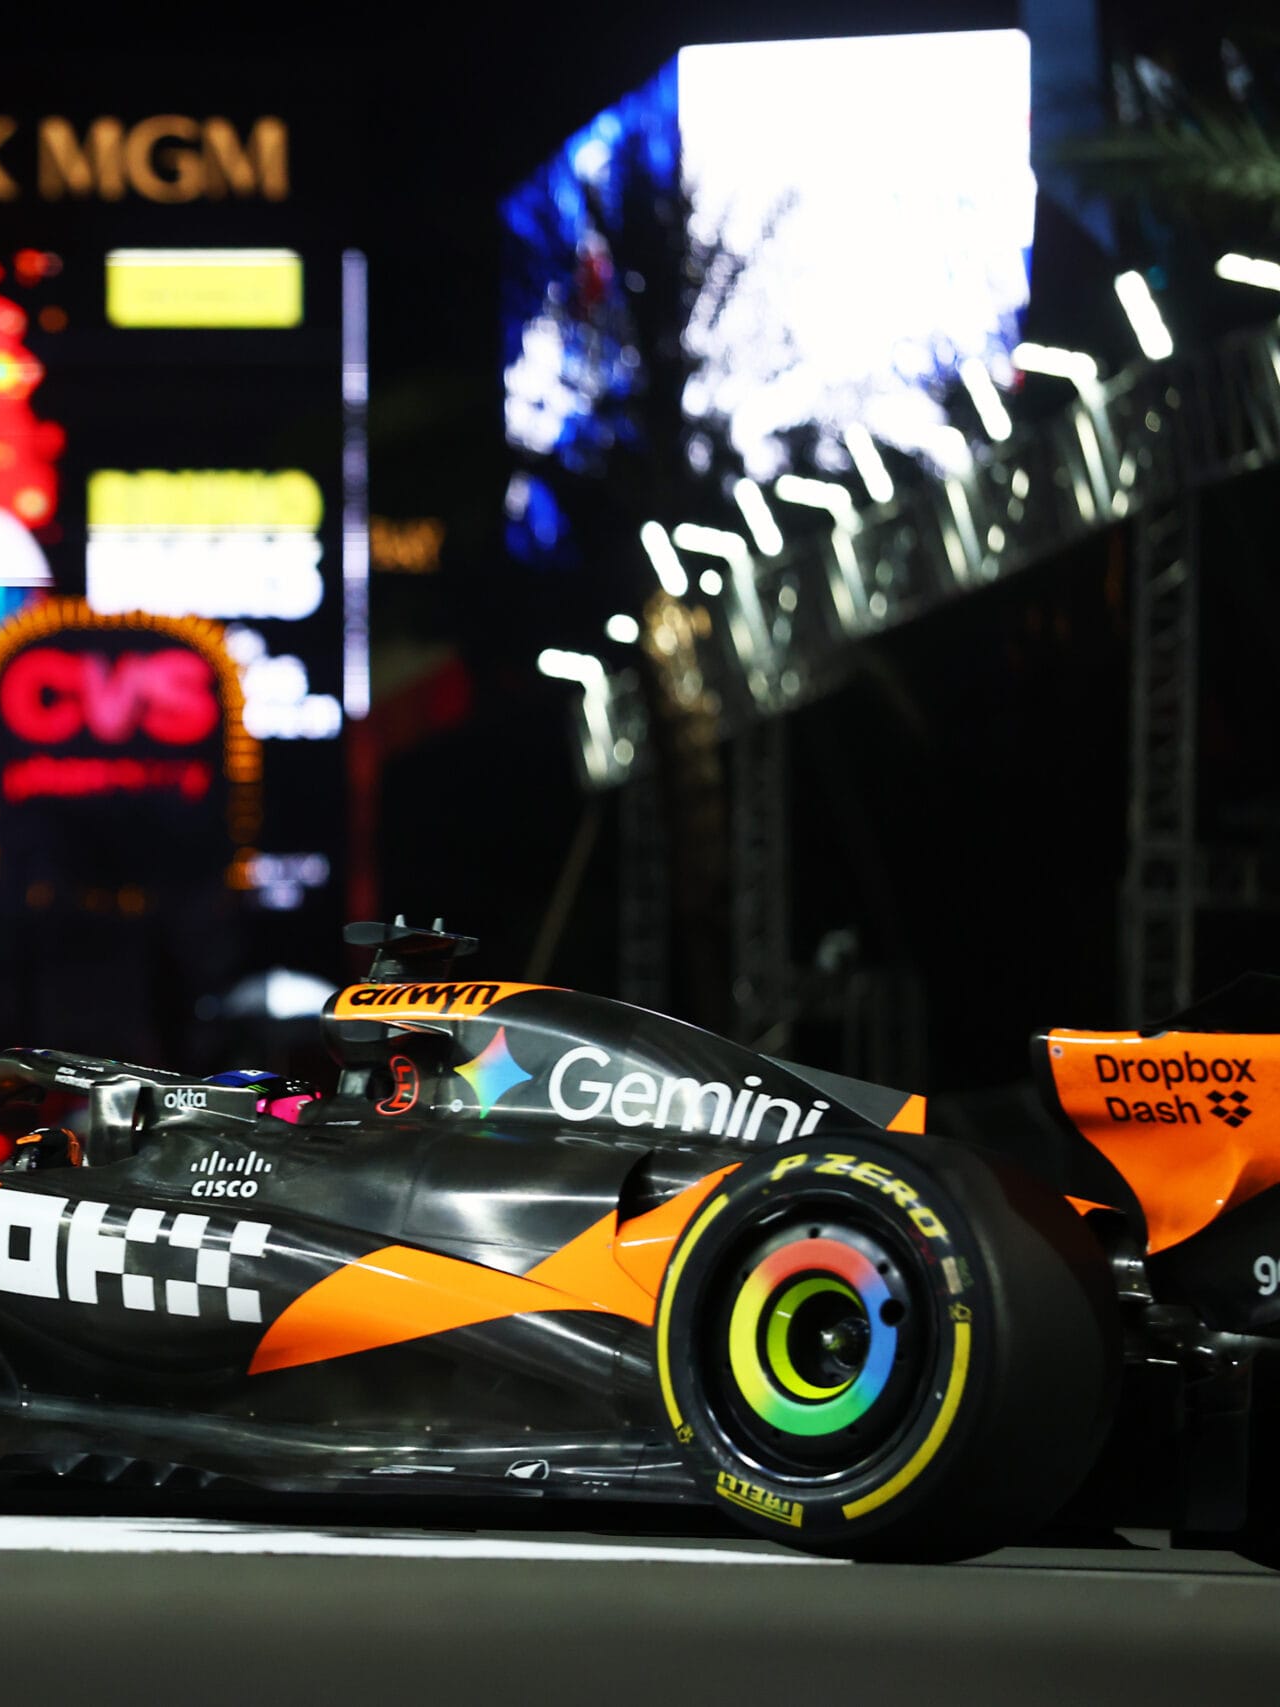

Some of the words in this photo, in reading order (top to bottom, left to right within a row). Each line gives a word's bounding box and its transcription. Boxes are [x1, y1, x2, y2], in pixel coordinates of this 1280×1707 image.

[38, 114, 289, 203] MGM
[0, 646, 220, 745] CVS
[349, 984, 500, 1014] allwyn
[164, 1088, 207, 1109] okta
[548, 1046, 831, 1145] Gemini
[1095, 1051, 1256, 1090] Dropbox
[1105, 1095, 1201, 1124] Dash
[770, 1153, 808, 1181] P
[814, 1153, 948, 1238] ZERO
[716, 1471, 803, 1528] PIRELLI
